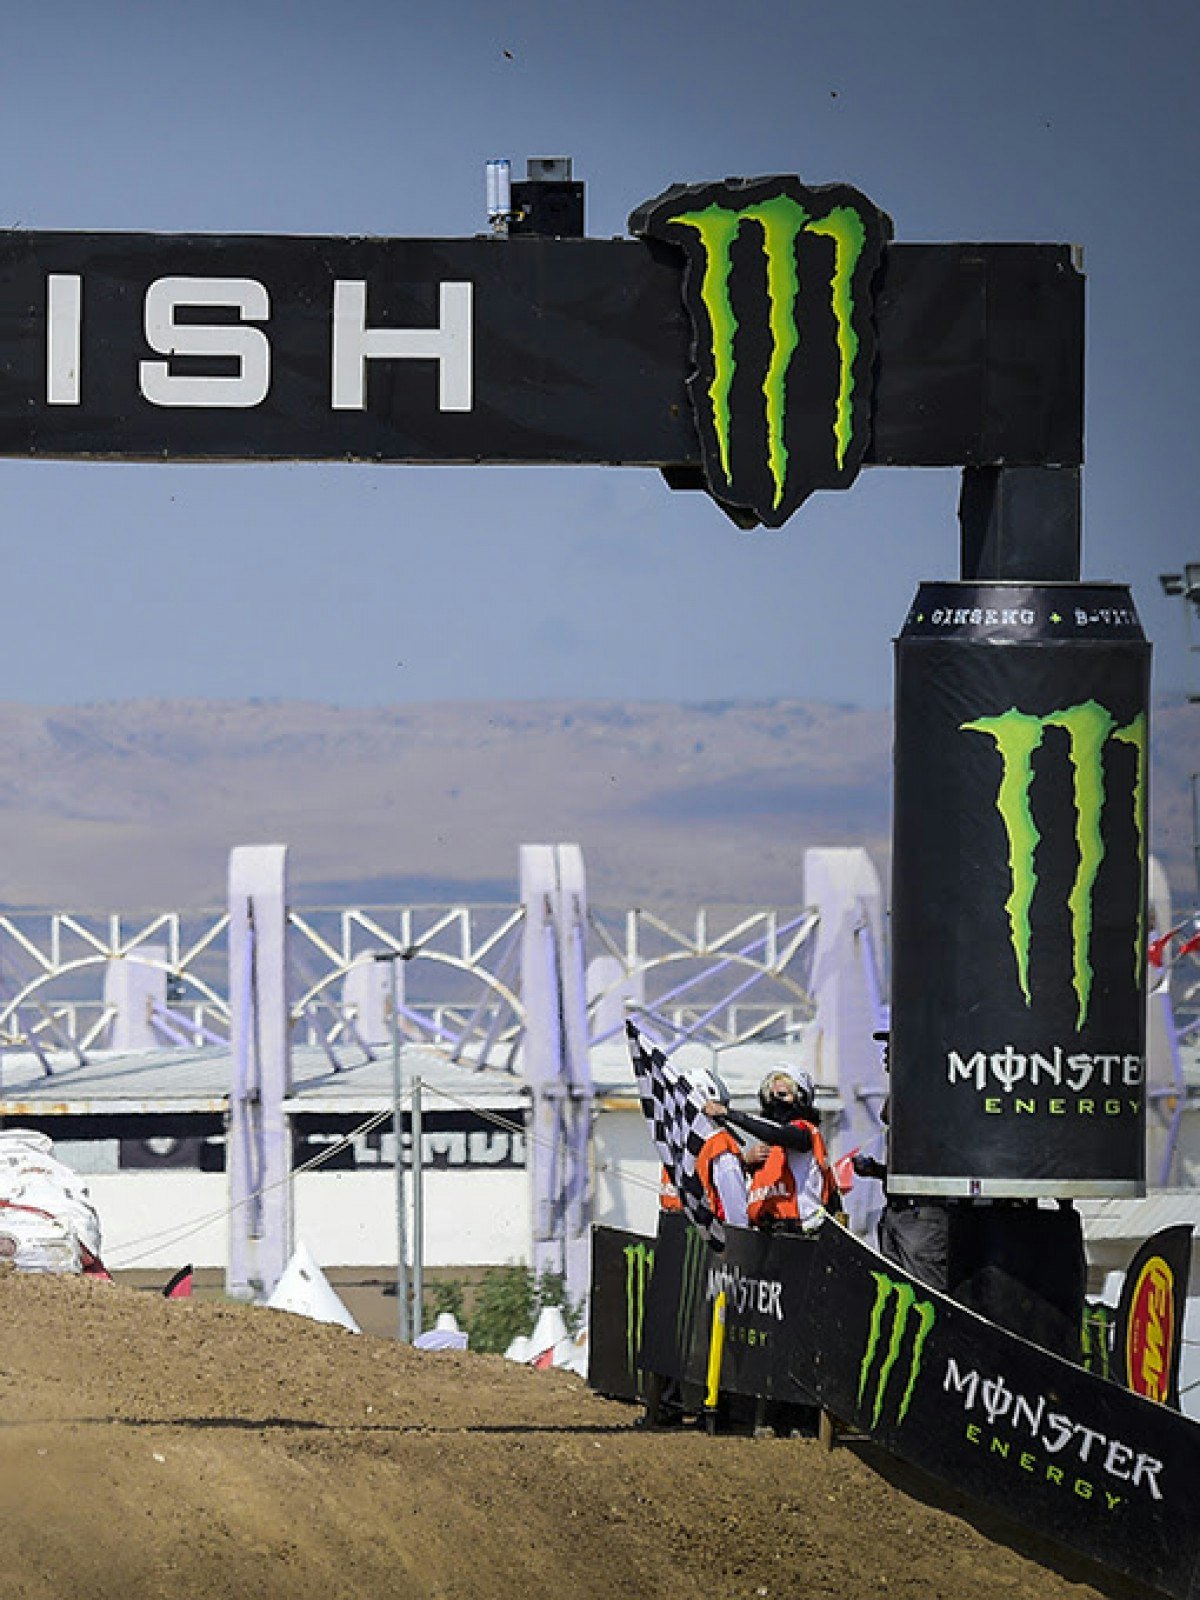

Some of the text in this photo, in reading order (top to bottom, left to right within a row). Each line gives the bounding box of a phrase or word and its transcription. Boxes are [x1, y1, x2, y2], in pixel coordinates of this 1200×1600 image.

[947, 1045, 1142, 1092] MONSTE
[943, 1358, 1164, 1500] MONSTER
[965, 1422, 1121, 1511] ENERGY
